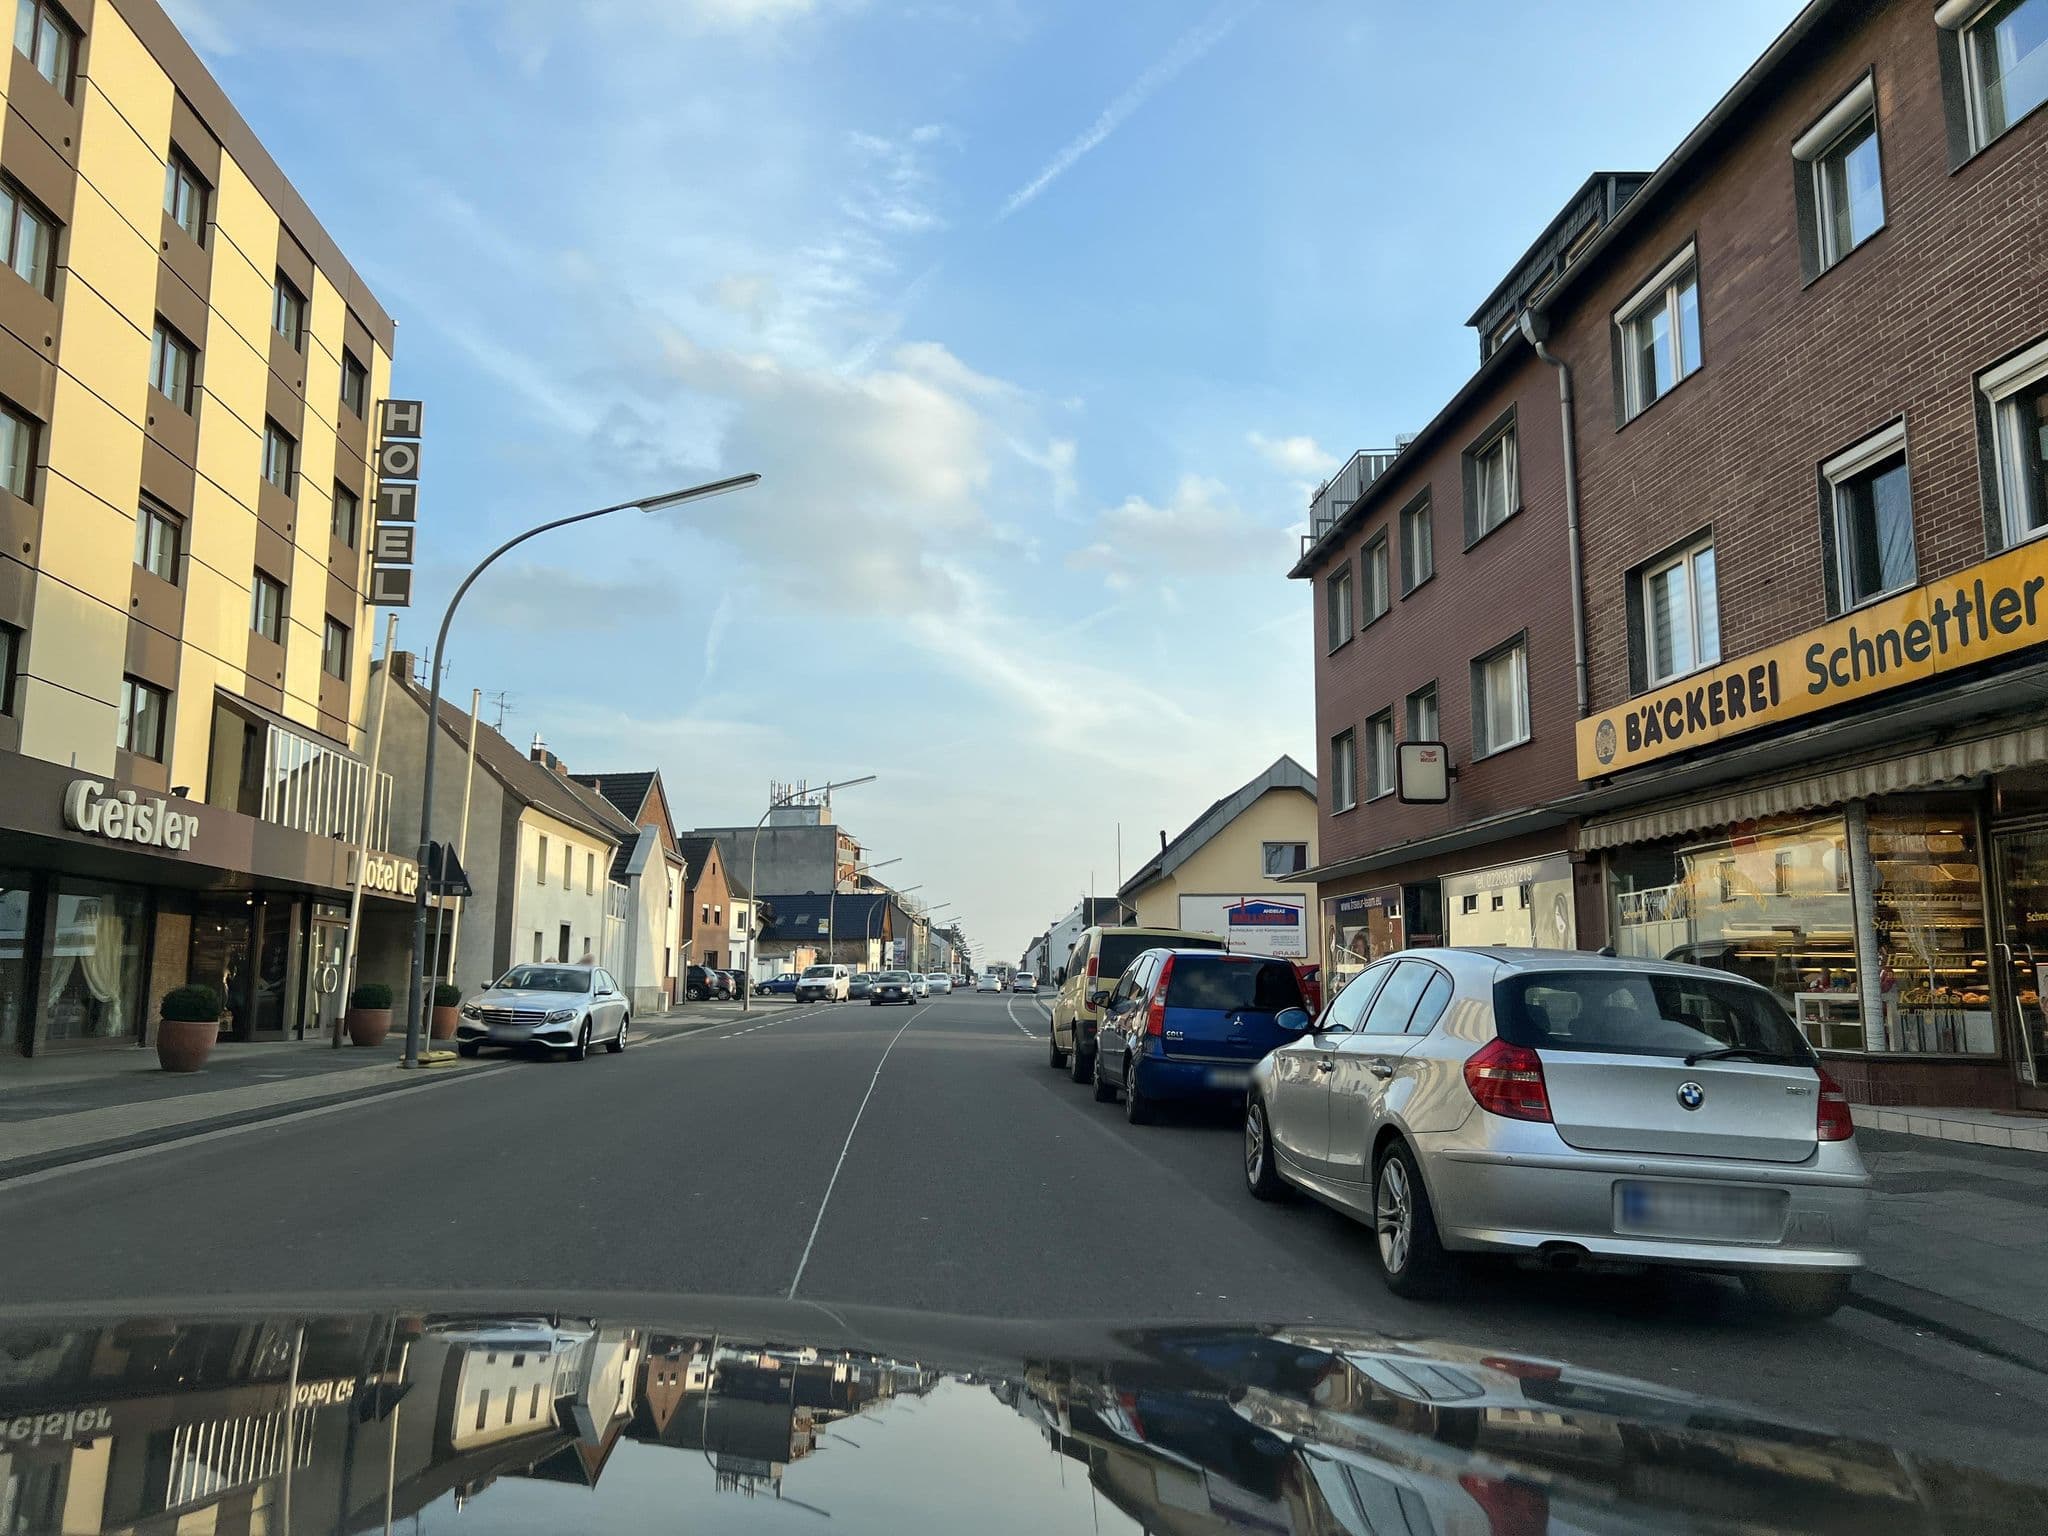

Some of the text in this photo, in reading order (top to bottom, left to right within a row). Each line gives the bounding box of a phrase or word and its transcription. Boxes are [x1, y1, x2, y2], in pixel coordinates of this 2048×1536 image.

[375, 403, 418, 601] HOTEL
[1626, 576, 2045, 752] BÄCKEREI Schnettler
[64, 779, 199, 851] Geisler
